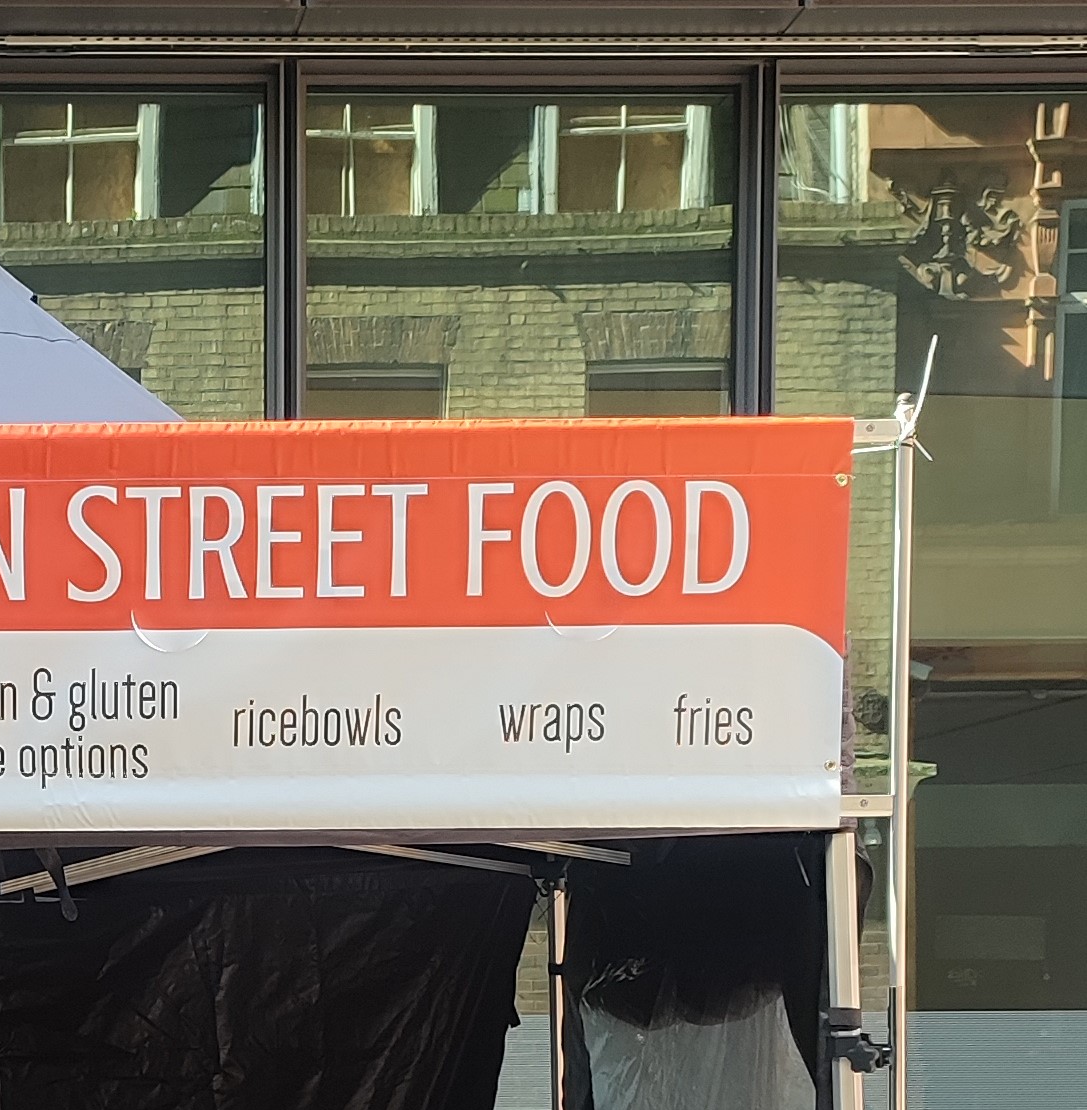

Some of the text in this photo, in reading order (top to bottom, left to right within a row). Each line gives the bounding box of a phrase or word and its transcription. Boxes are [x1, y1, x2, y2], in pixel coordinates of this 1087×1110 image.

[66, 484, 429, 603] STREET
[466, 480, 751, 598] FOOD
[31, 667, 57, 720] &
[69, 667, 179, 732] gluten
[233, 694, 402, 747] ricebowls
[673, 694, 754, 746] fries
[499, 702, 606, 753] wraps
[19, 736, 149, 789] options
